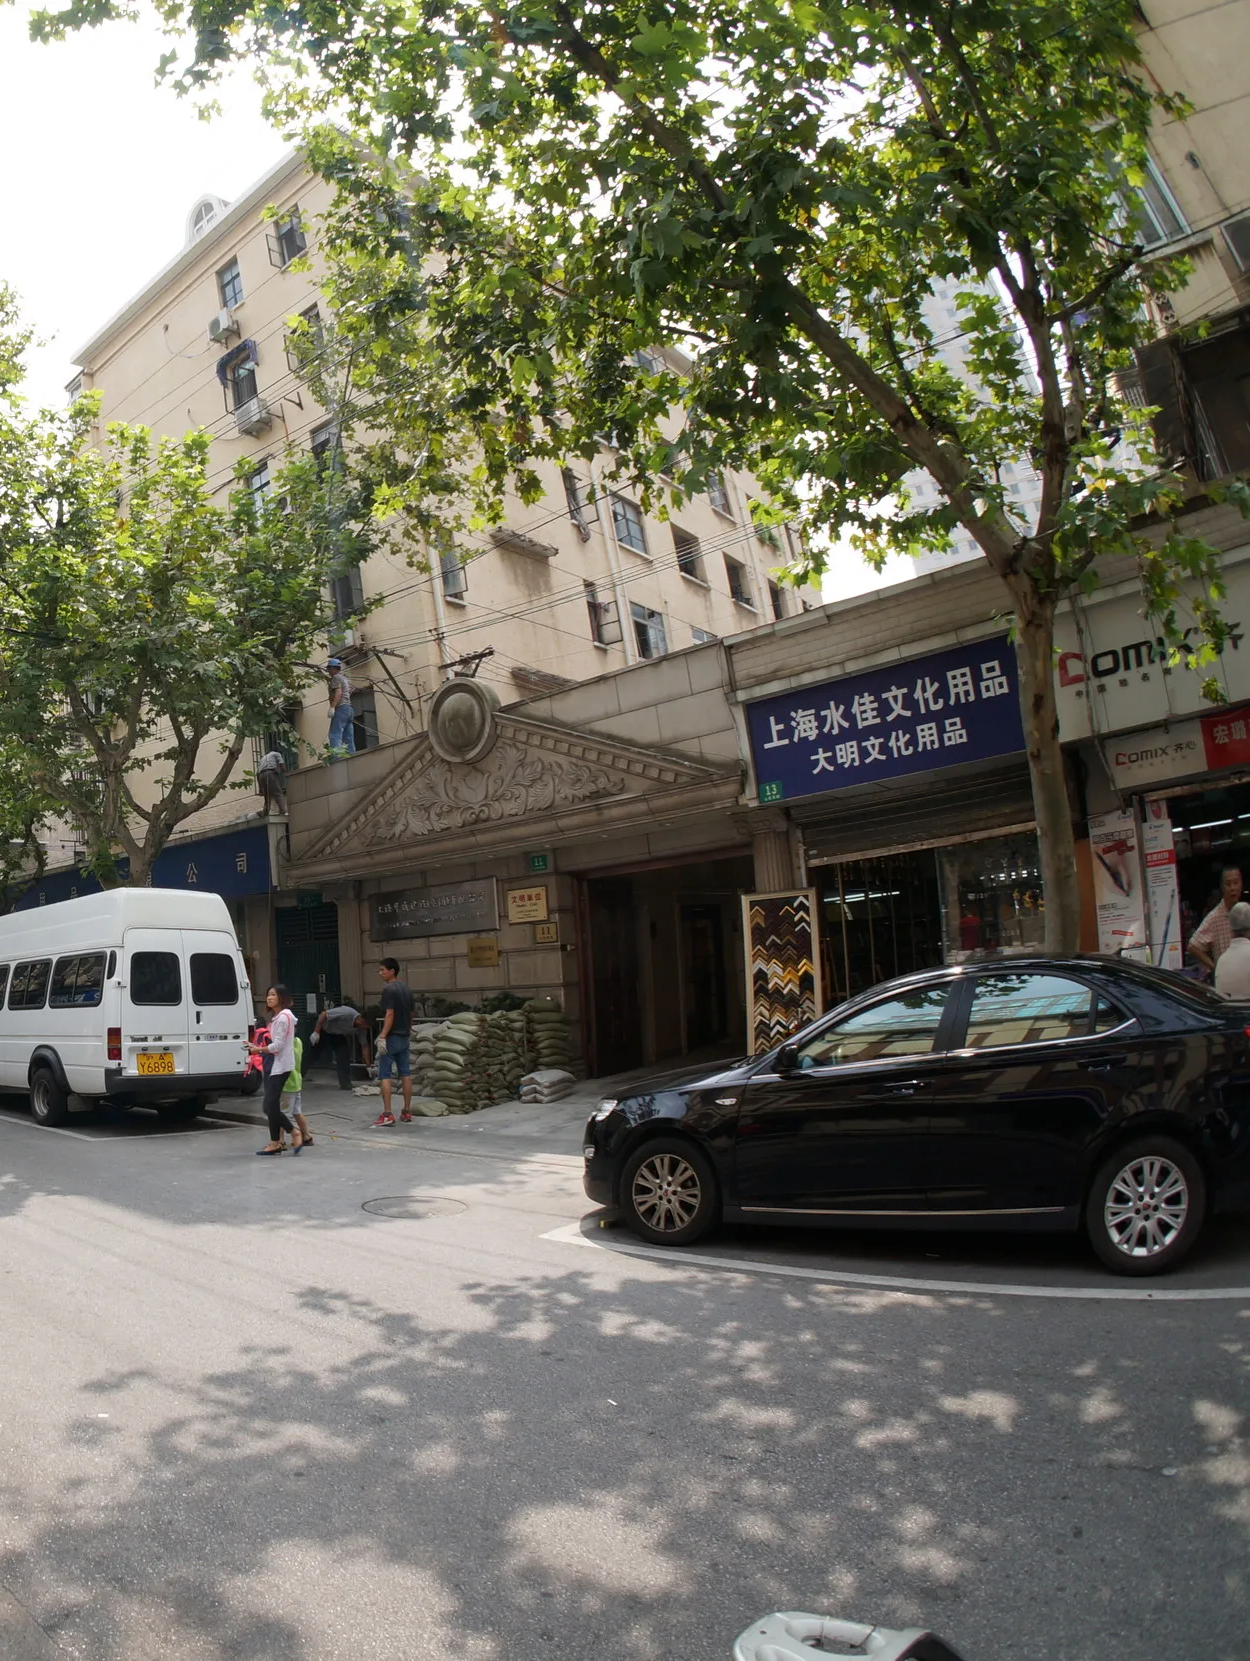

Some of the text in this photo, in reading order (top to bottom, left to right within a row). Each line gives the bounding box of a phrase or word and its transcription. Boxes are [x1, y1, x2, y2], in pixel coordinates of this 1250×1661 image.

[763, 660, 1009, 749] 上海水佳文化用品
[810, 717, 968, 774] 大明文化用品
[765, 784, 777, 796] 13
[511, 893, 542, 904] 文明单位
[139, 1061, 174, 1073] Y6898
